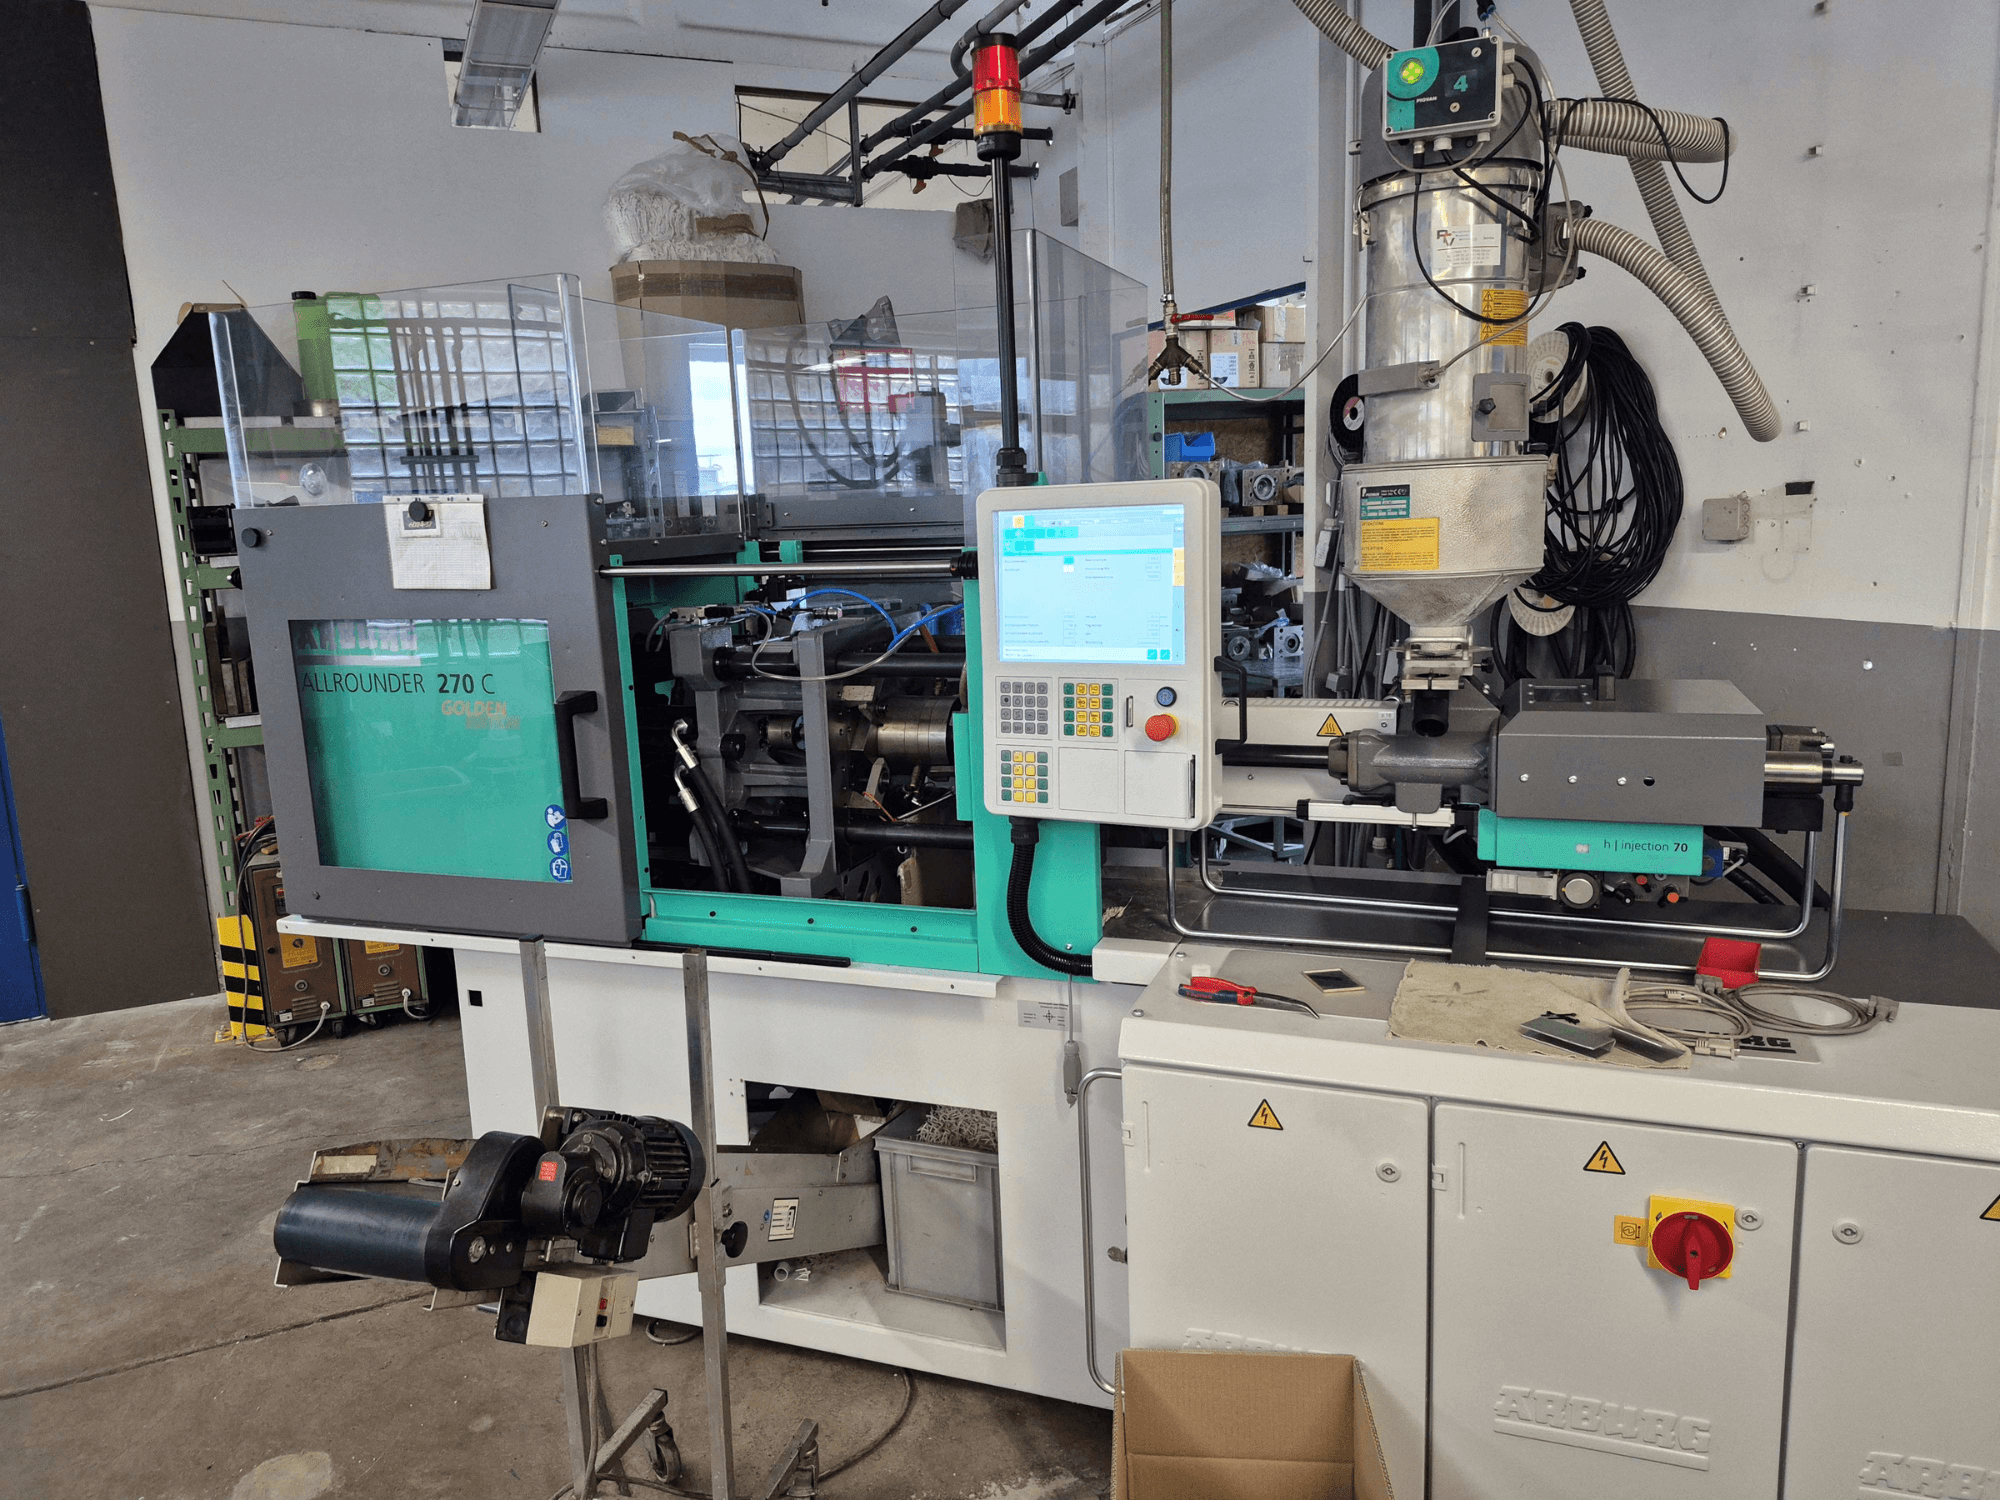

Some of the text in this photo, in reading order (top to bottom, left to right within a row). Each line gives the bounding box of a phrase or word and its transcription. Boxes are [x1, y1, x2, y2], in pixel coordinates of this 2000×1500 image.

[1453, 74, 1469, 92] 4
[301, 672, 495, 695] ALLROUNDER 270 C
[441, 699, 507, 717] GOLDEN
[1604, 839, 1611, 849] h
[1621, 841, 1669, 852] injection
[1673, 842, 1688, 852] 70
[1494, 1385, 1711, 1453] ARBURG
[1858, 1451, 2000, 1500] ARB
